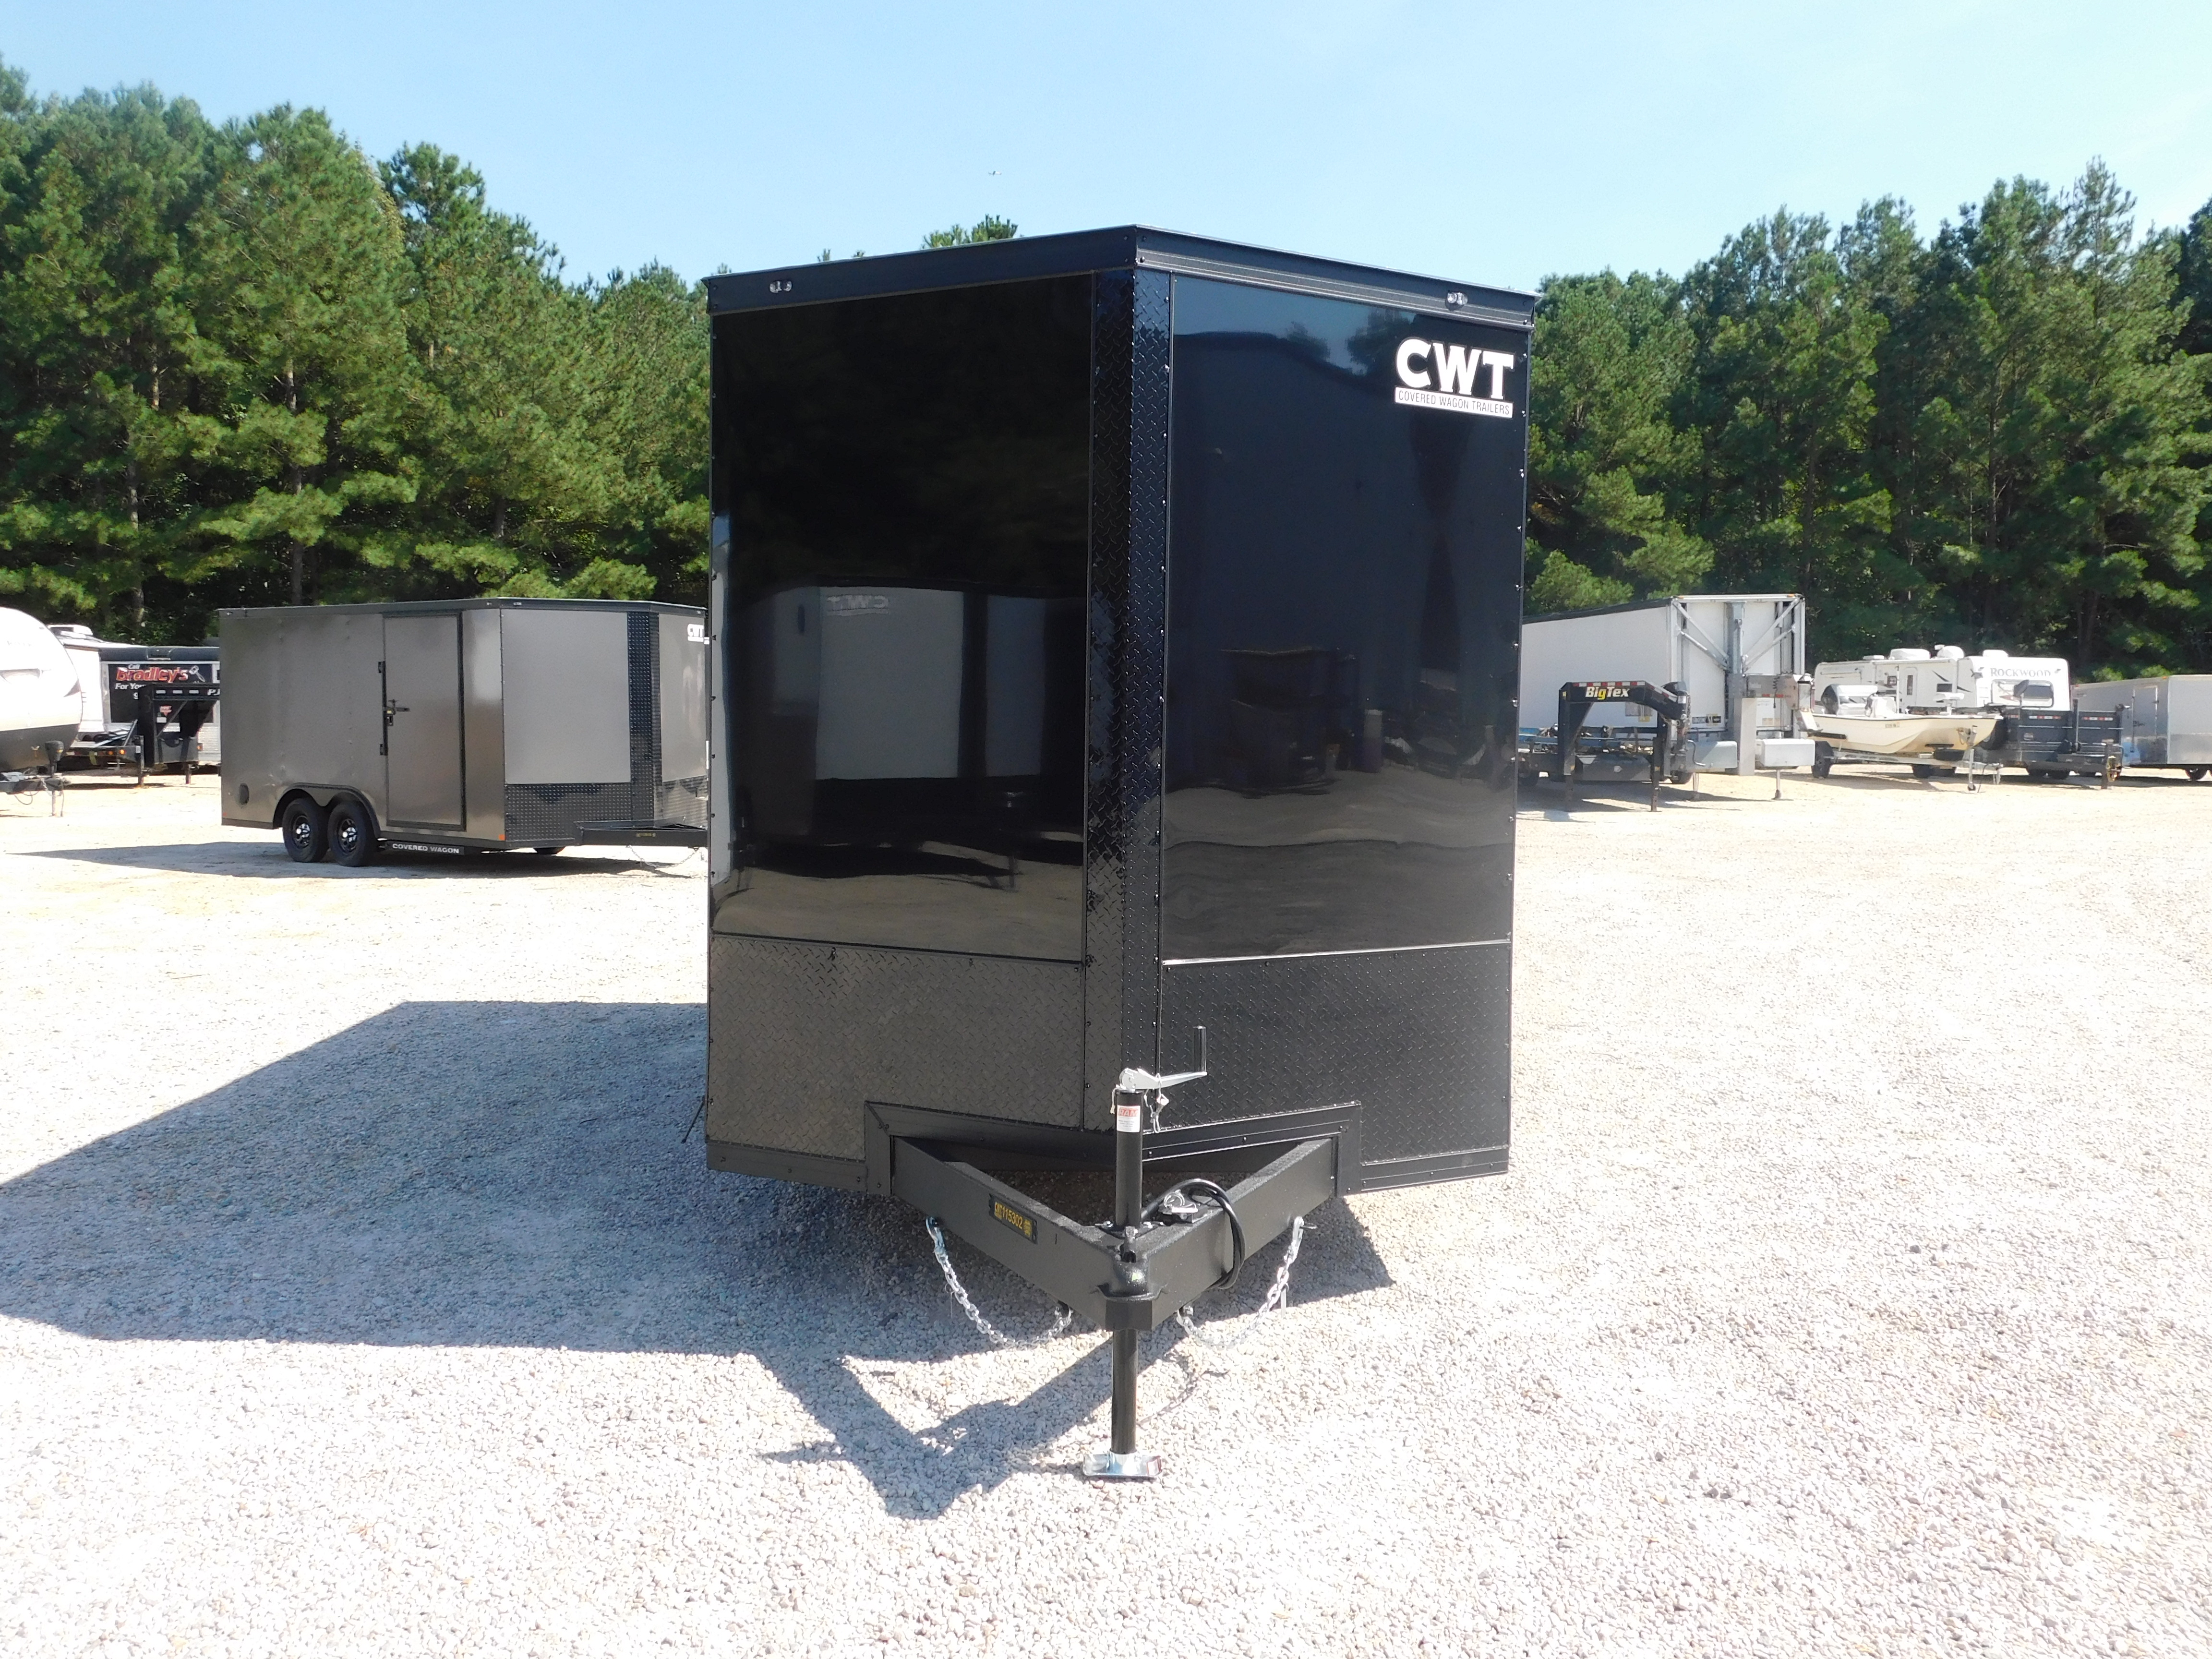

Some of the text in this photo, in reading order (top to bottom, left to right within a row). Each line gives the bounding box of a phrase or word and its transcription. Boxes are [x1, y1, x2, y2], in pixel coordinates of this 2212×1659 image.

[1396, 338, 1514, 399] CWT
[1398, 390, 1510, 415] COVERED WAGON TRAILERS
[1990, 668, 2051, 677] ROCKWOOD
[392, 843, 428, 852] COVERED
[1002, 1206, 1023, 1229] 115302
